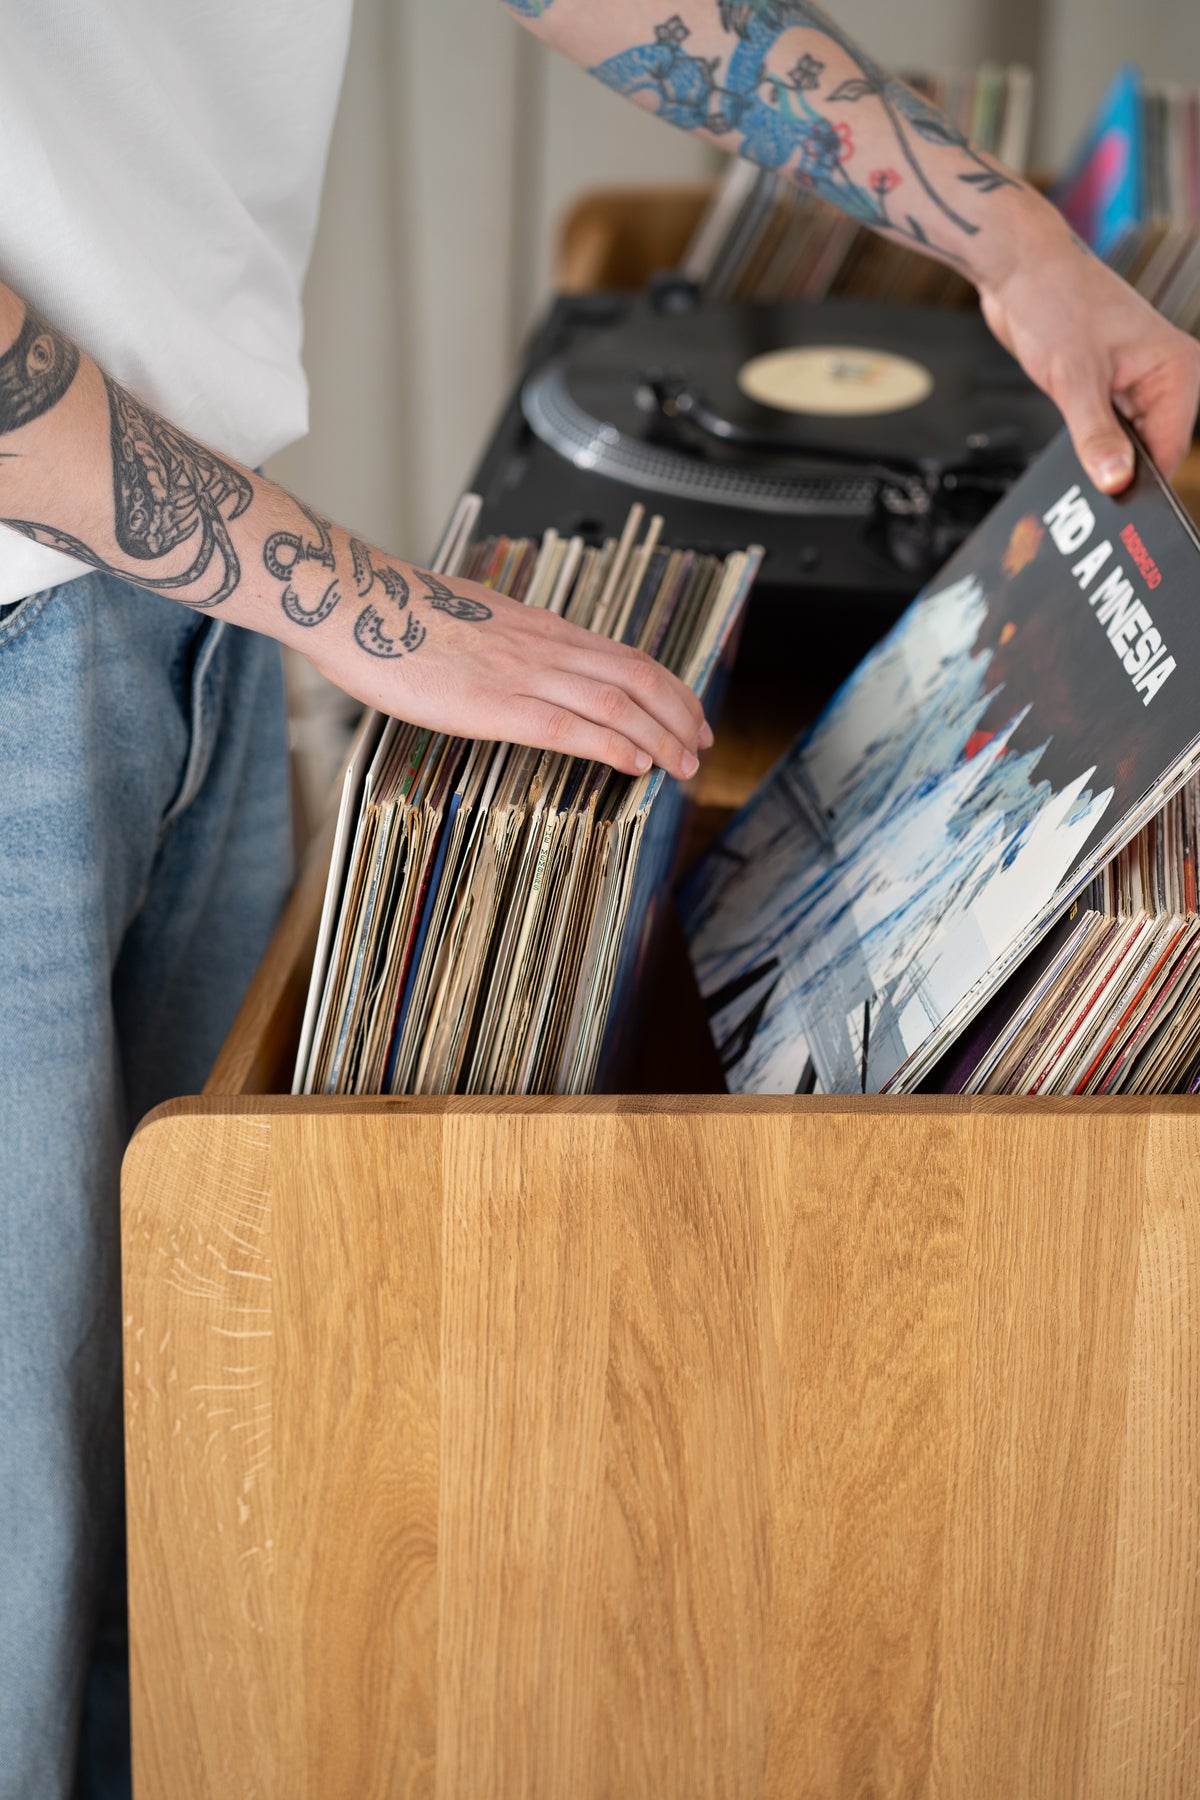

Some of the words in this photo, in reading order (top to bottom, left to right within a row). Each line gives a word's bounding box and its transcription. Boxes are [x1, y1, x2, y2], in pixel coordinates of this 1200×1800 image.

[1042, 484, 1096, 556] KID
[1071, 539, 1114, 590] A
[1088, 565, 1177, 707] MNESIA
[544, 825, 552, 843] THE
[533, 849, 548, 891] MEMBERS
